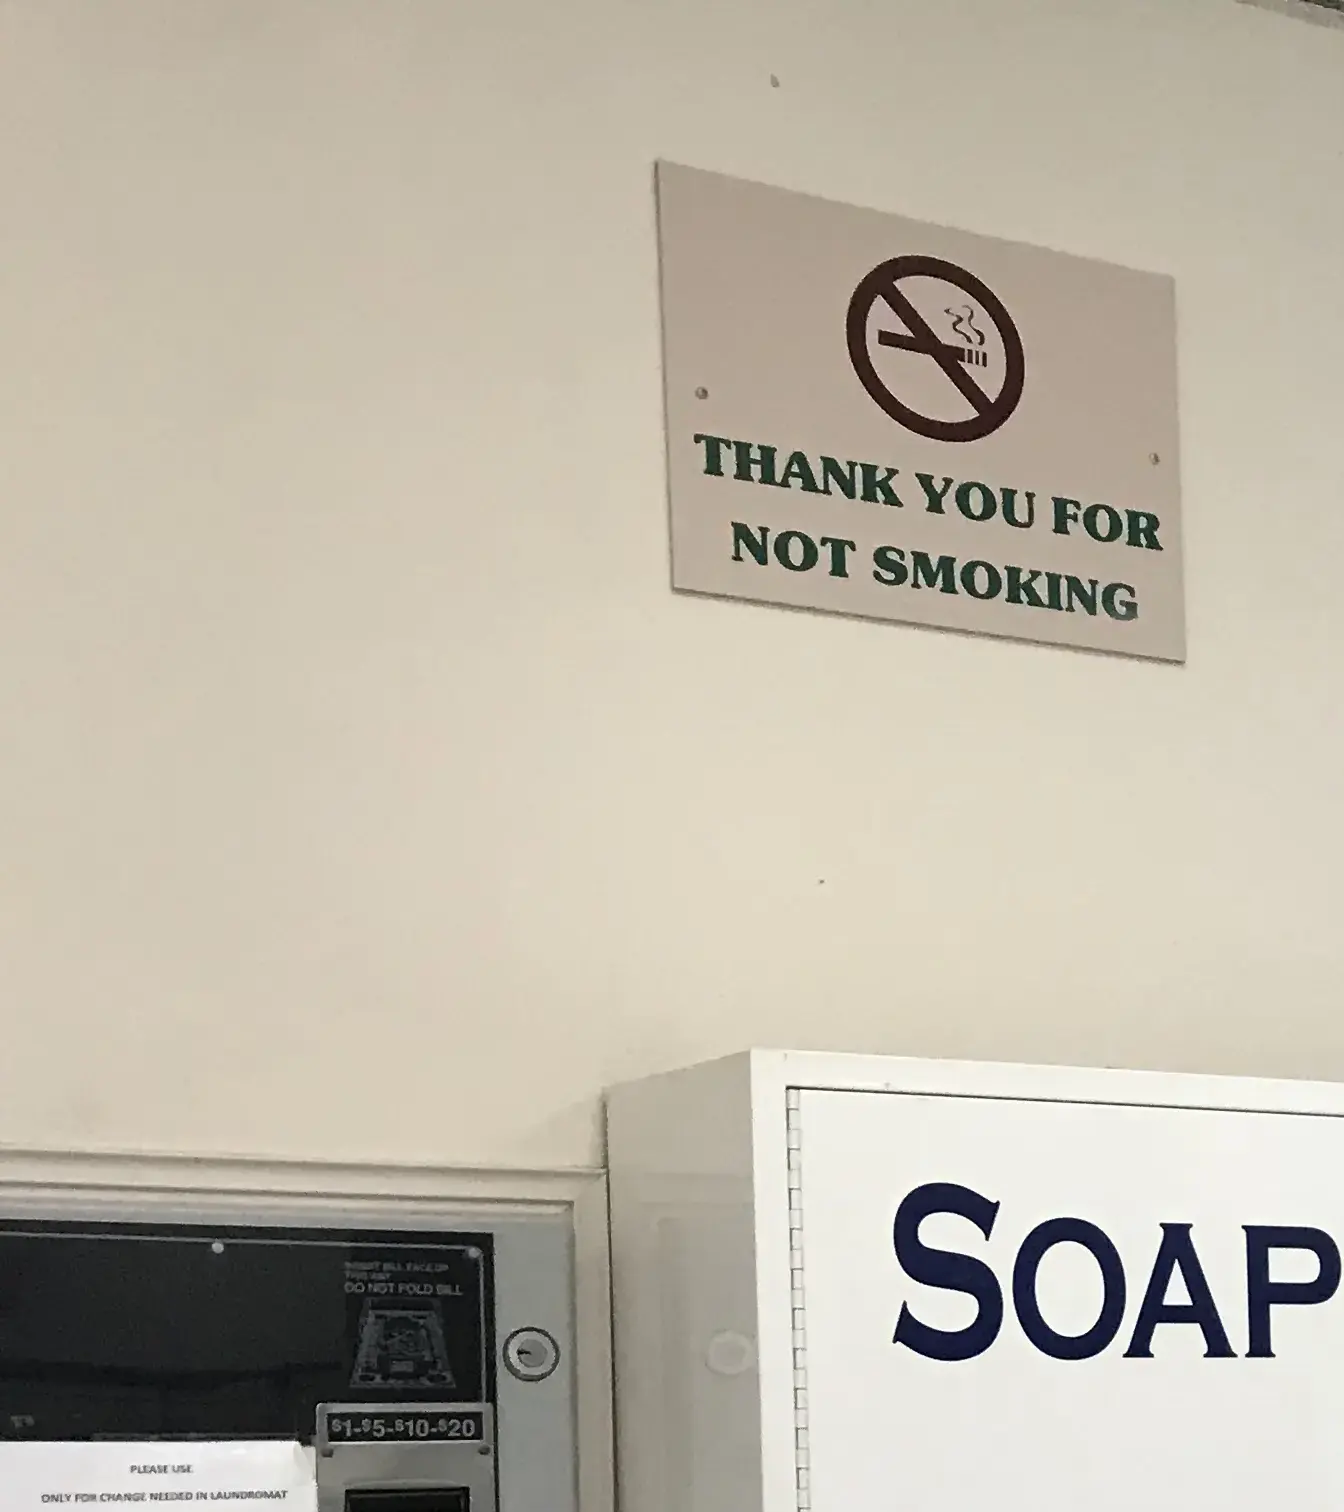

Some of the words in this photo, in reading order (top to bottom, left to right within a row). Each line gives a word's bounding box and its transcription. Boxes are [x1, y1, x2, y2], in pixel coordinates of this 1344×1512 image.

[693, 433, 903, 509] THANK
[914, 472, 1036, 529] YOU
[1052, 496, 1163, 551] FOR
[731, 522, 856, 578] NOT
[873, 545, 1138, 621] SMOKING
[344, 1281, 365, 1294] DO
[368, 1282, 395, 1295] NOT
[398, 1283, 433, 1296] FOLD
[436, 1284, 463, 1296] BILL
[892, 1182, 1342, 1363] SOAP
[40, 1493, 72, 1503] ONLY
[75, 1493, 97, 1503] FOR
[100, 1492, 146, 1503] CHANGE
[150, 1491, 193, 1501] NEEDED
[196, 1490, 208, 1501] IN
[210, 1489, 288, 1500] LAUNDROMAT
[130, 1464, 168, 1475] PLEASE
[172, 1464, 193, 1474] USE
